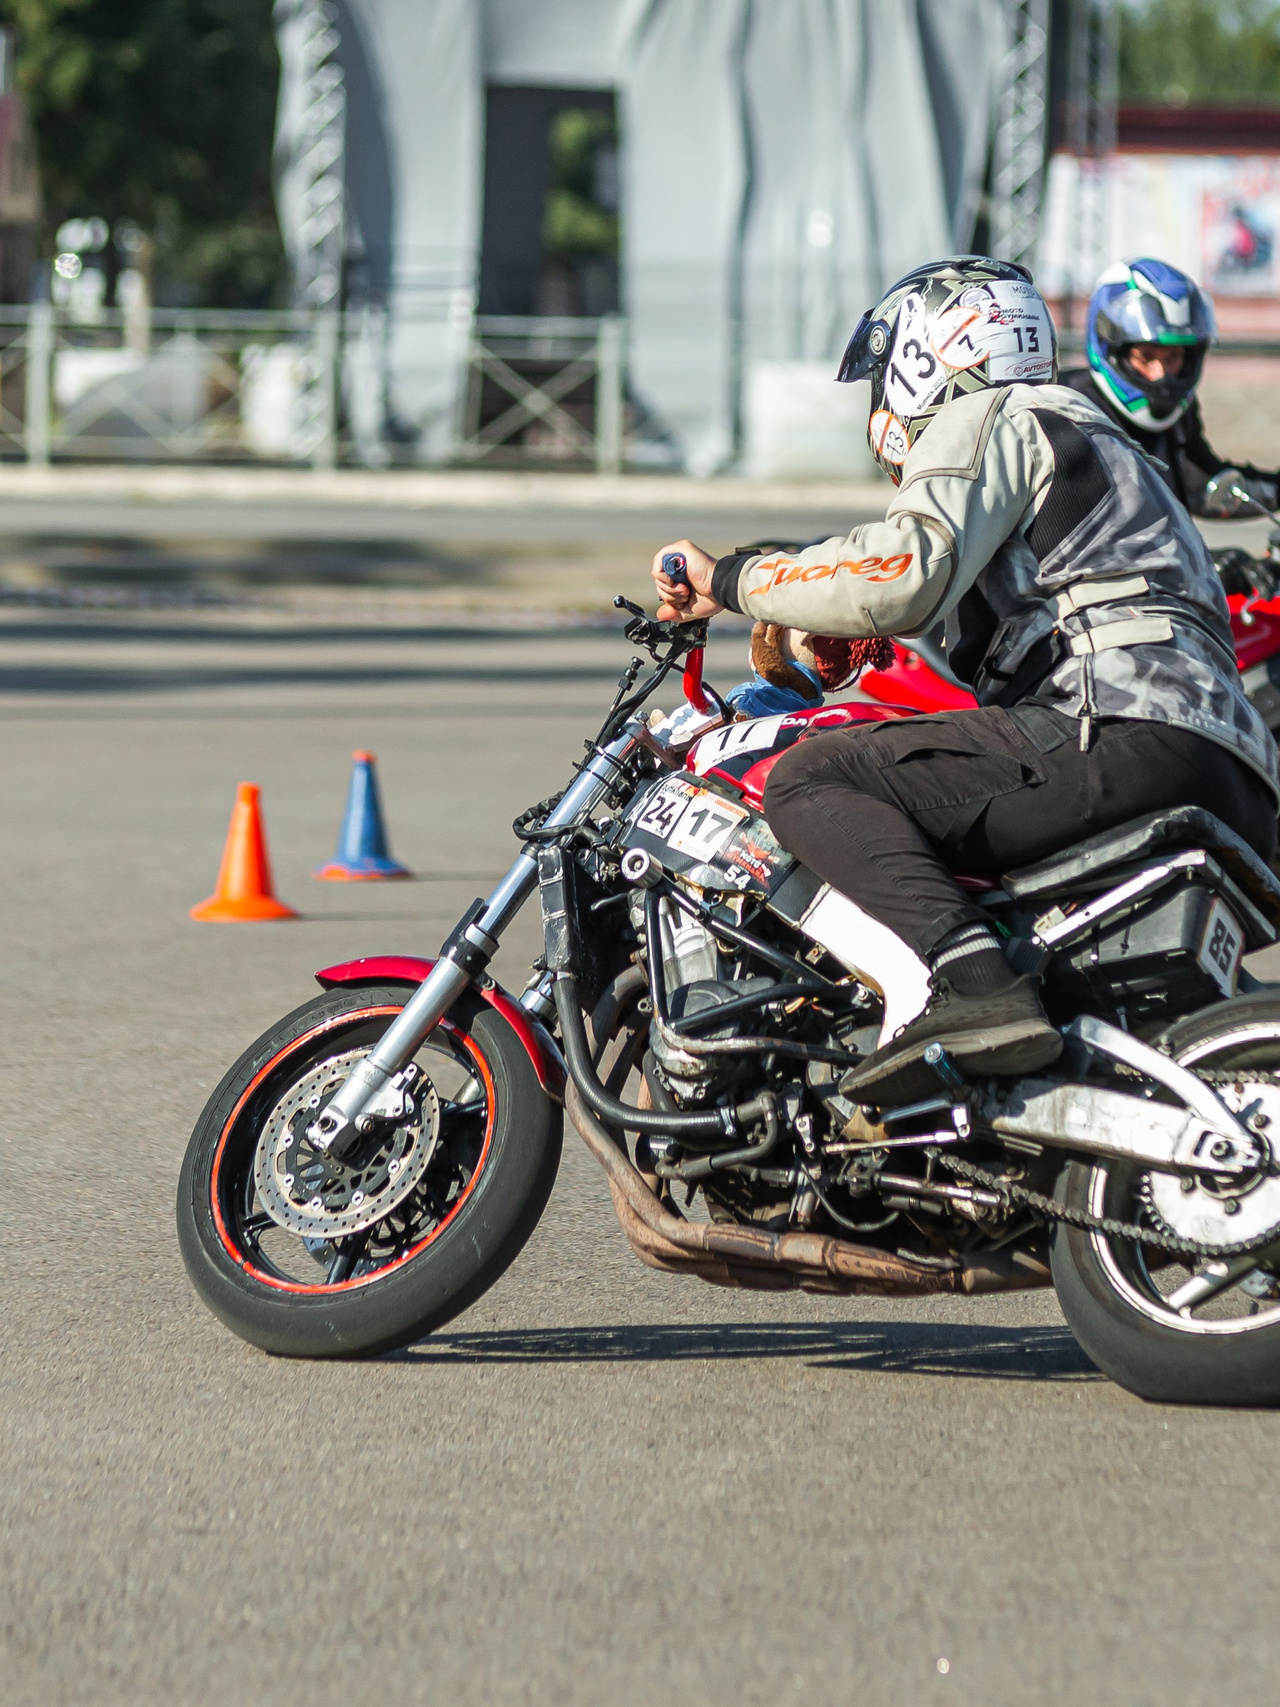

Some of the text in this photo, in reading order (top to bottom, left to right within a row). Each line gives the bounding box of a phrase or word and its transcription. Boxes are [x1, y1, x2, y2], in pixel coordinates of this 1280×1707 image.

[957, 333, 975, 352] 7
[1013, 326, 1040, 353] 13
[890, 338, 937, 398] 13
[886, 430, 905, 456] 13
[641, 795, 677, 831] 24
[688, 807, 734, 844] 17
[740, 849, 762, 868] MOTO
[723, 864, 751, 890] 54
[1208, 917, 1237, 976] 85
